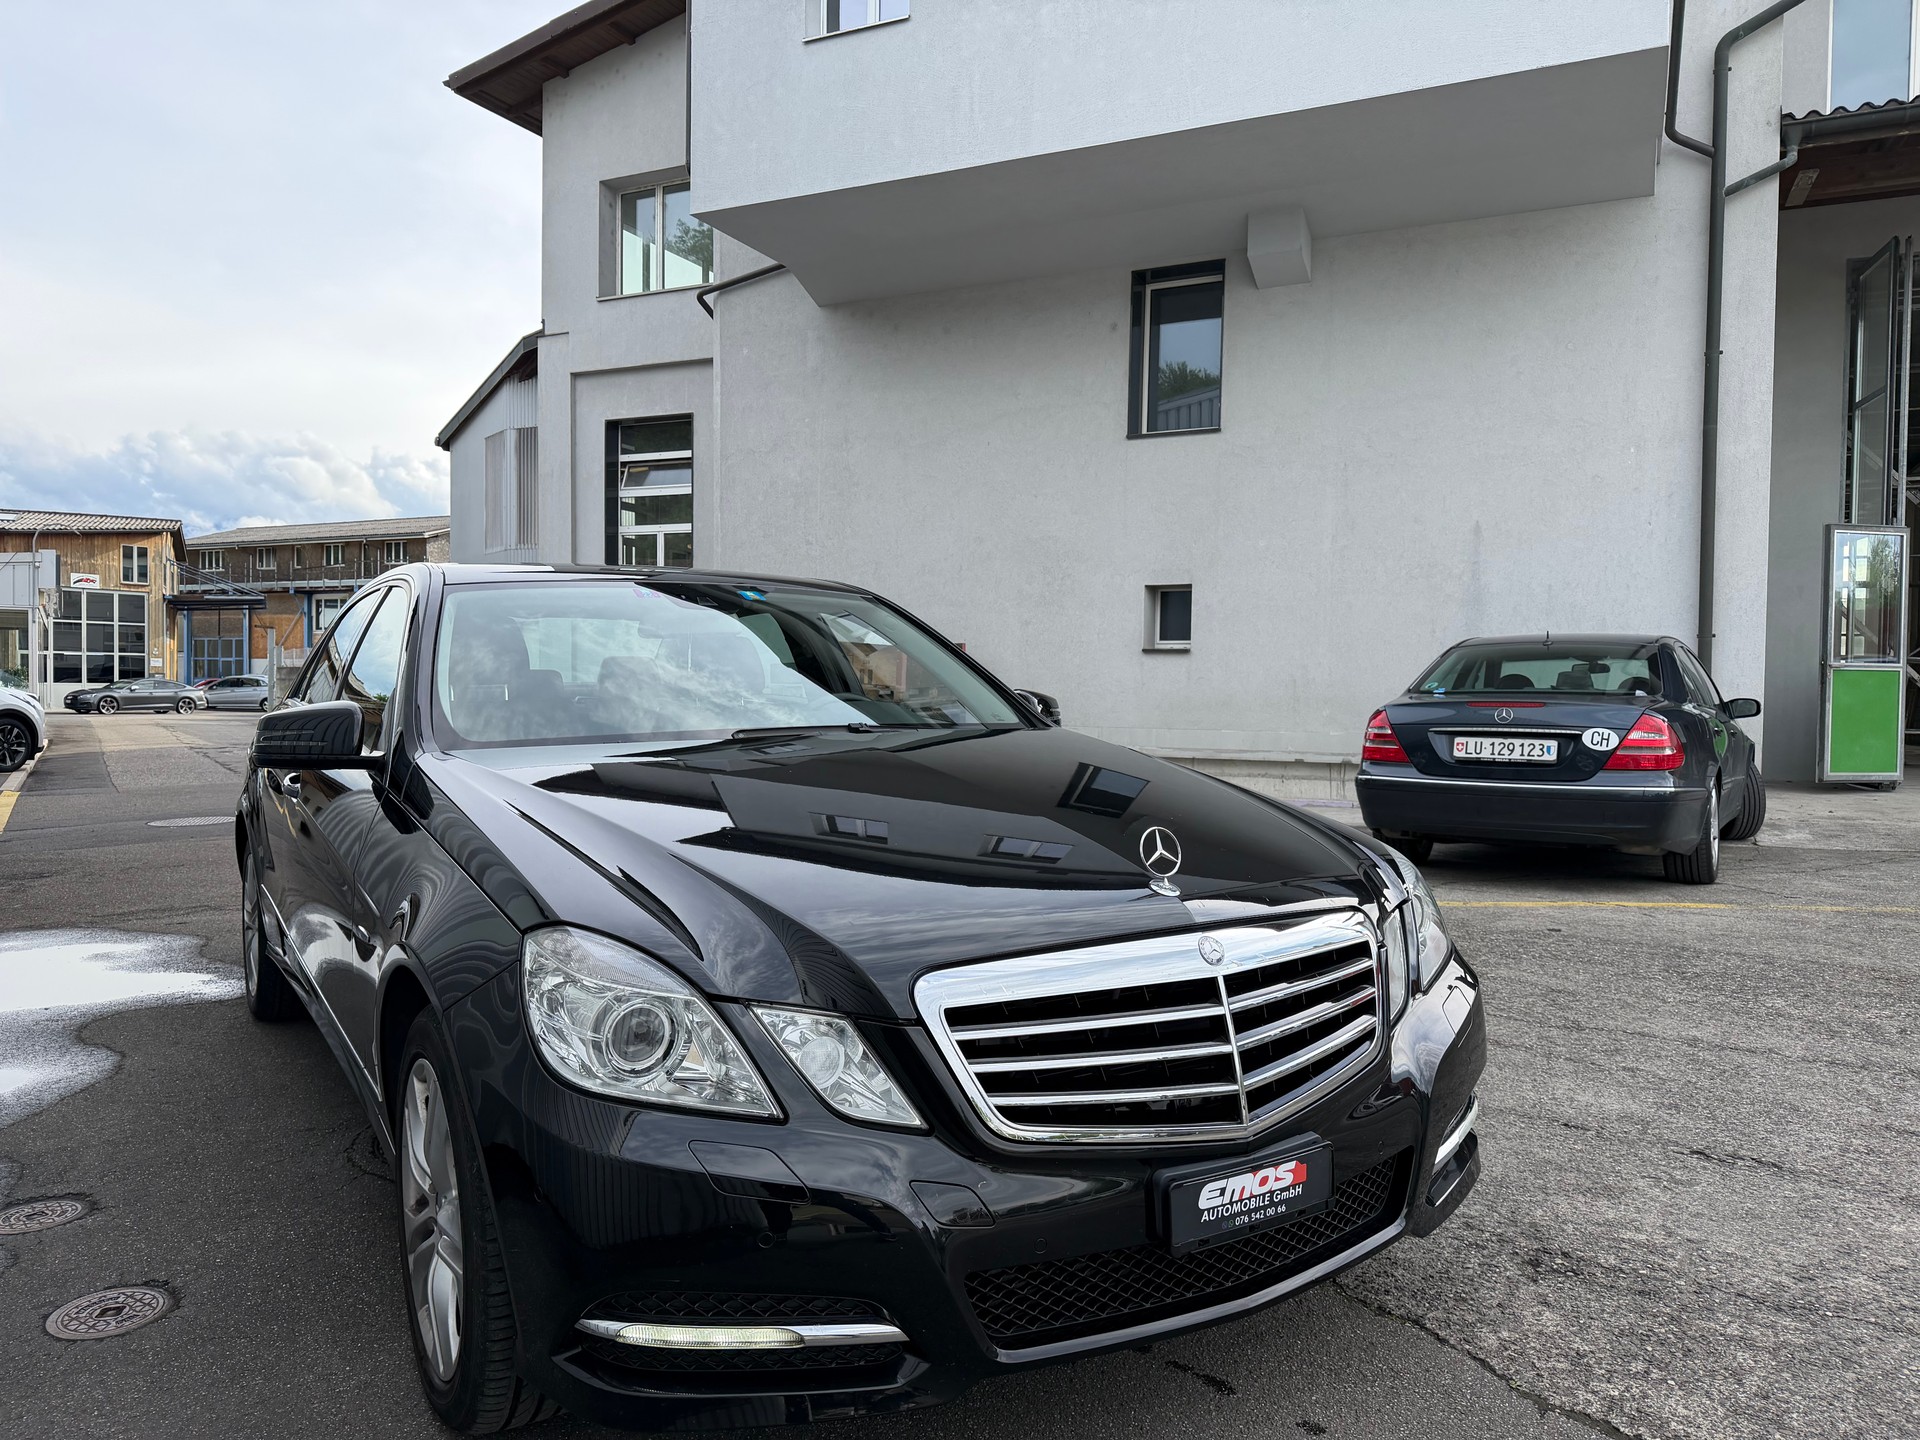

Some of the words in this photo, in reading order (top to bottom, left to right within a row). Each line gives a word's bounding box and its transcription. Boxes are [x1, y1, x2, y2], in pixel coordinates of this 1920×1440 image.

[1590, 730, 1611, 748] CH
[1201, 1195, 1270, 1223] AUTOMOBILE
[1273, 1184, 1303, 1202] GmbH
[1235, 1215, 1249, 1226] 076
[1251, 1210, 1265, 1221] 542
[1266, 1207, 1276, 1217] 00
[1277, 1203, 1286, 1214] 66
